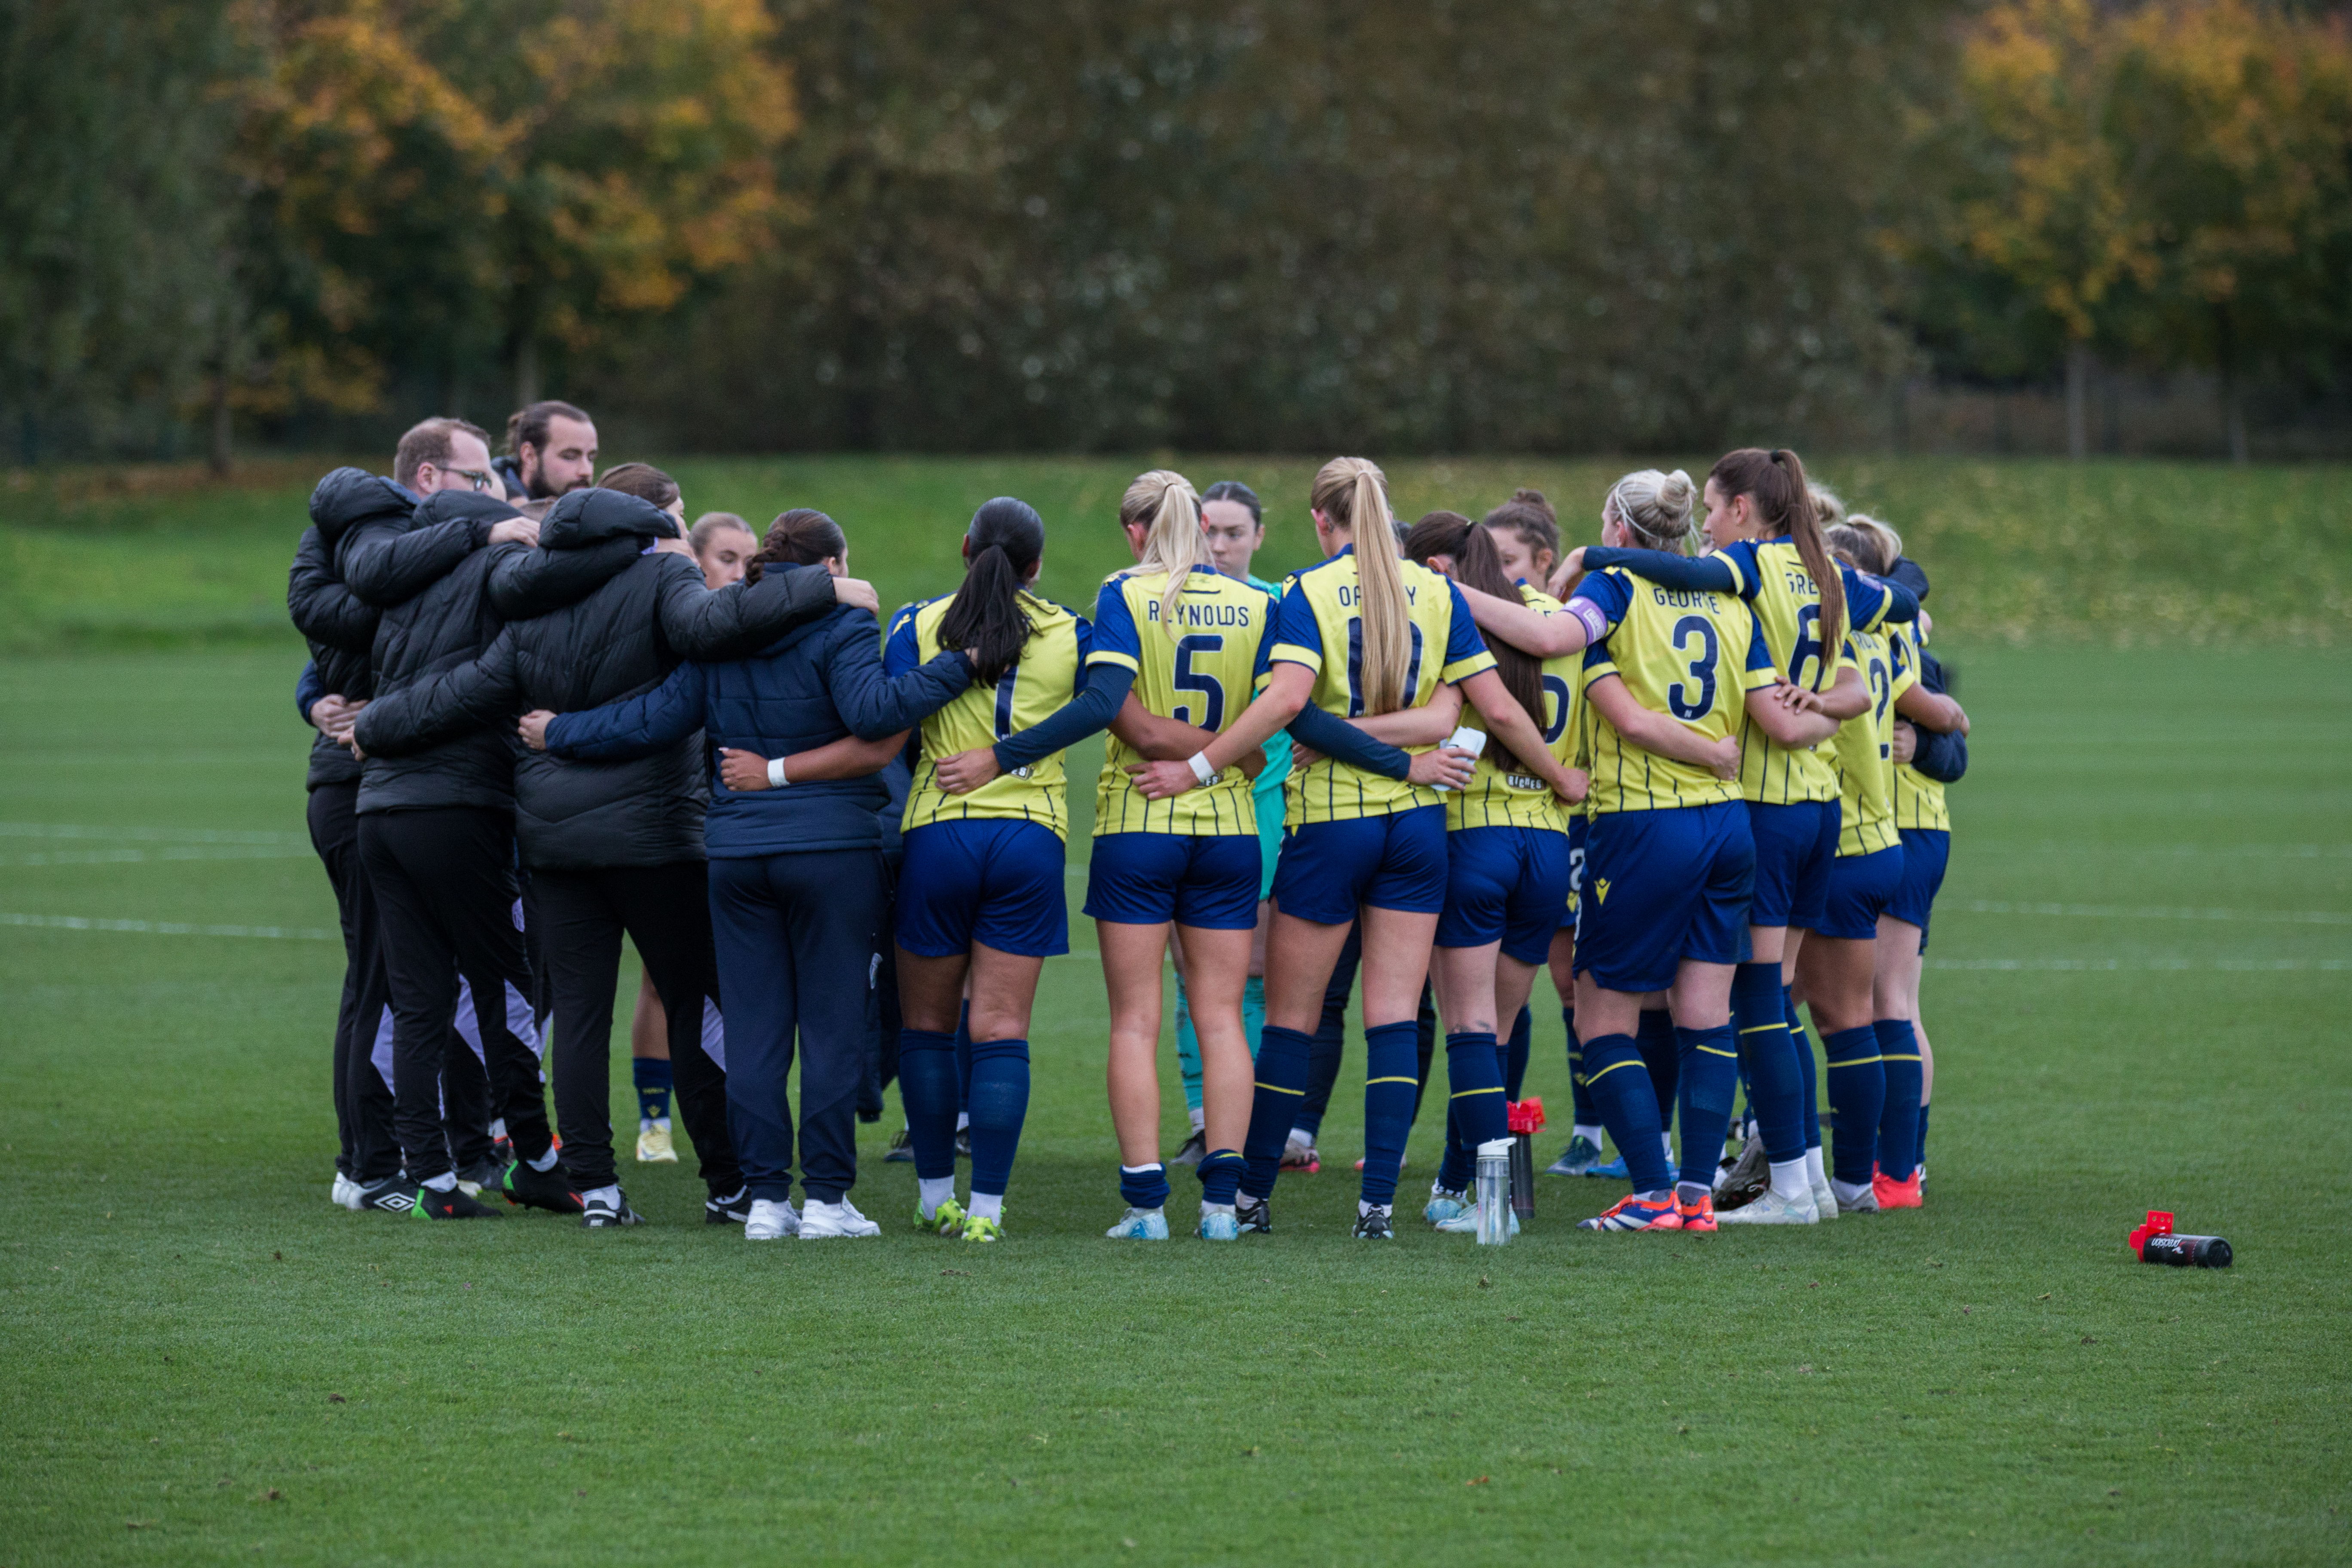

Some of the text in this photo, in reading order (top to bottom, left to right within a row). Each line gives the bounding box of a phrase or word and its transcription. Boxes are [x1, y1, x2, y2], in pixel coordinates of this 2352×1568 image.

[1148, 600, 1249, 627] RYNOLDS
[1338, 585, 1416, 606] OAY
[1172, 633, 1225, 733] 5
[1667, 614, 1719, 723] 3
